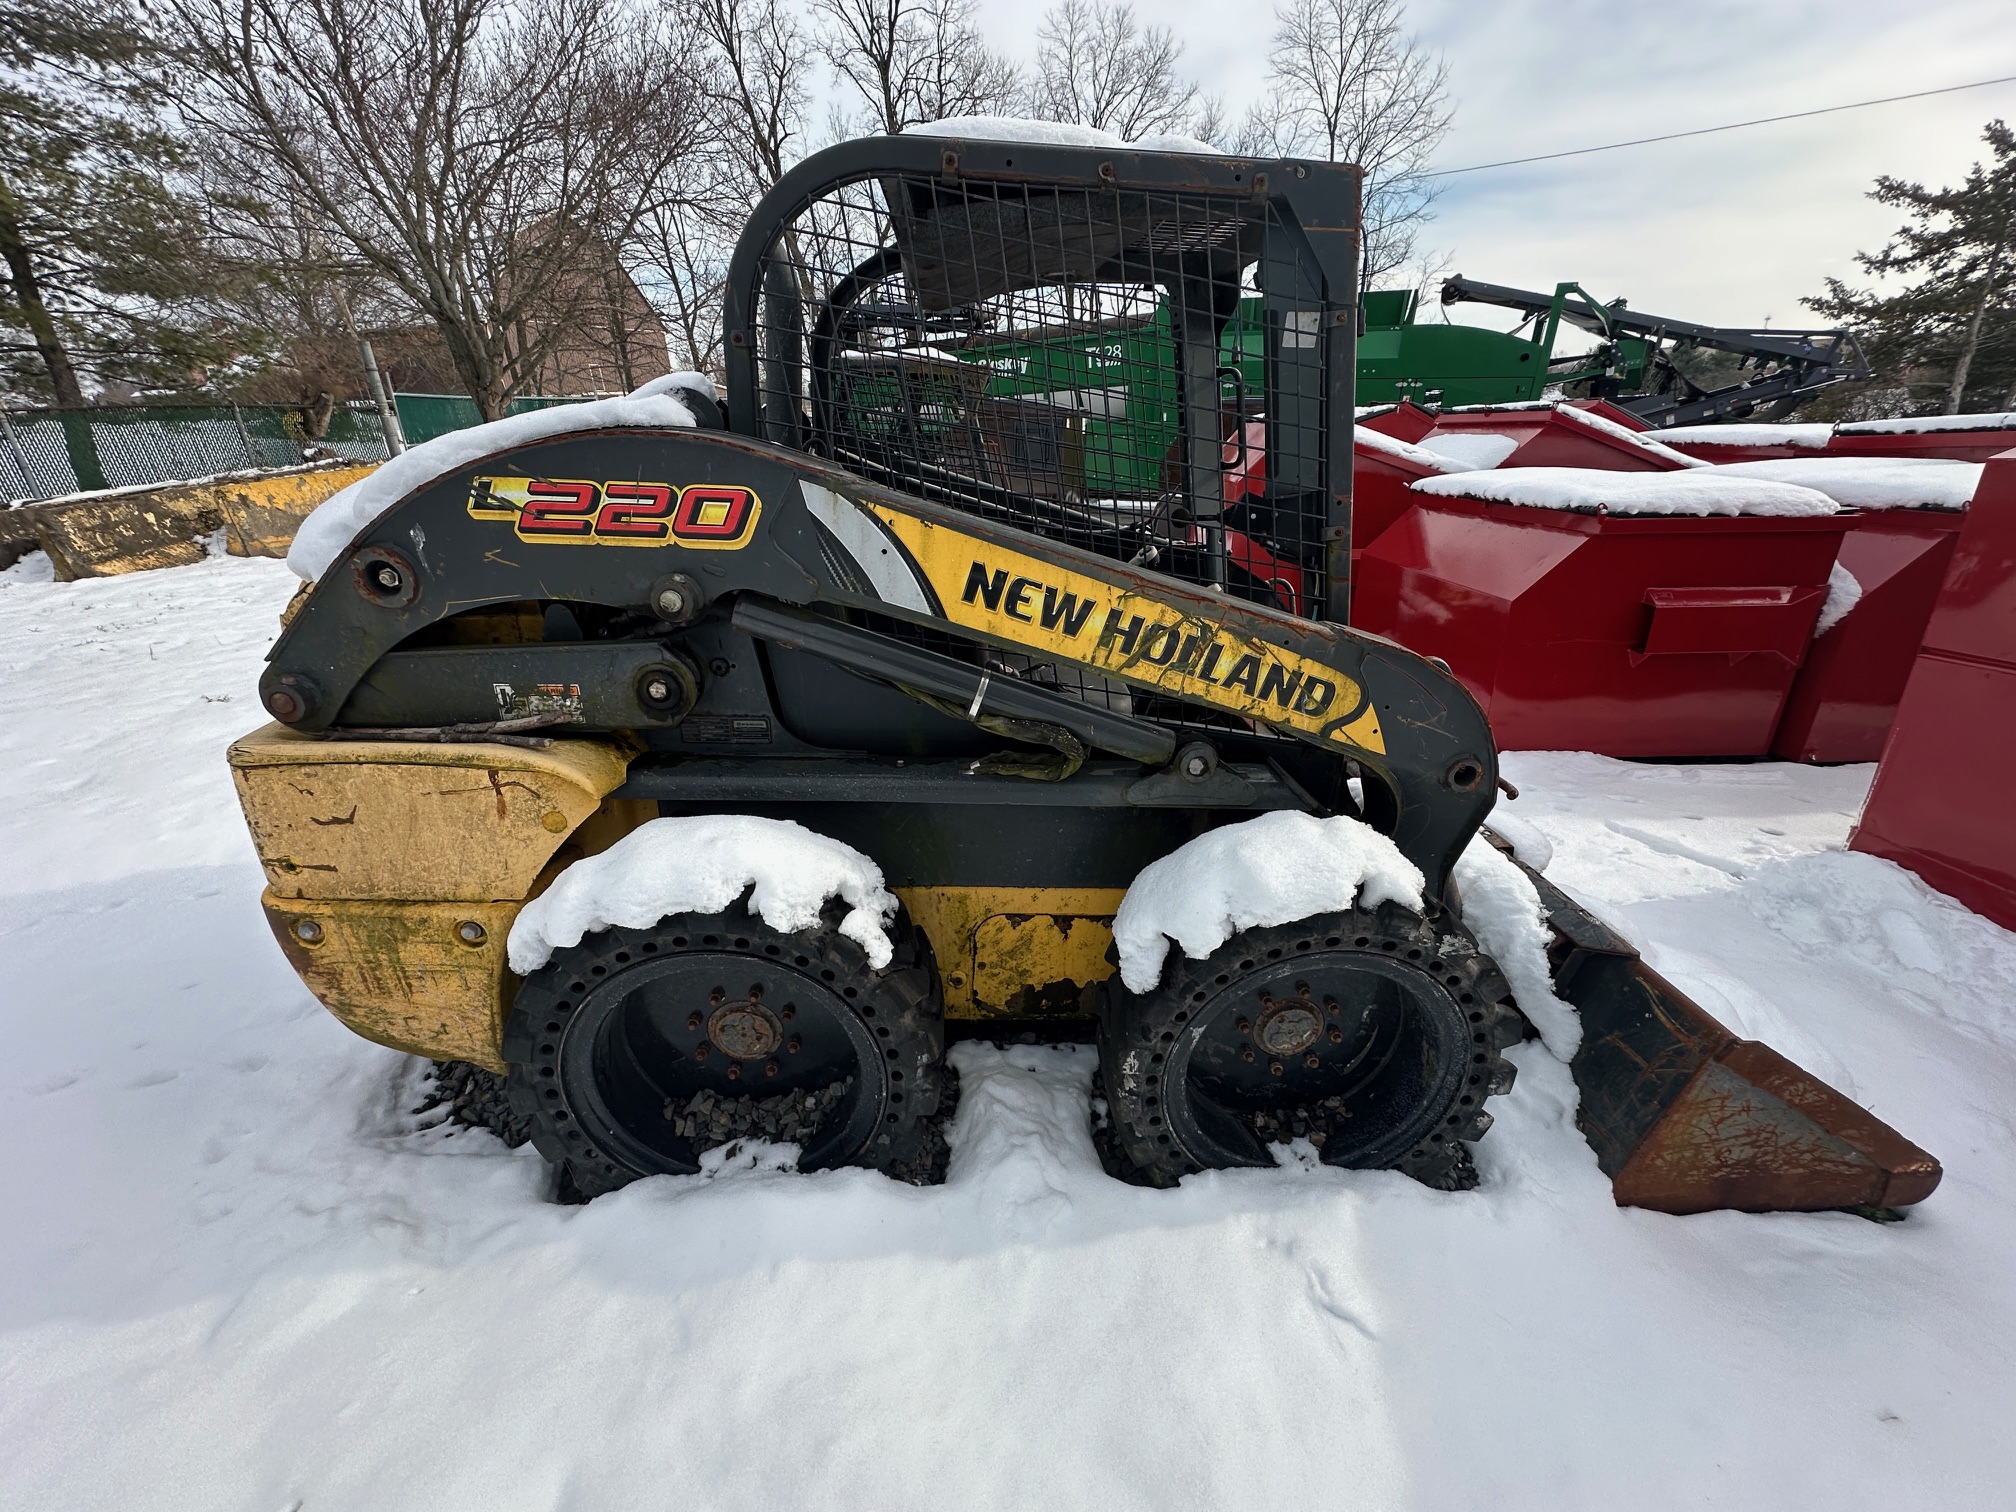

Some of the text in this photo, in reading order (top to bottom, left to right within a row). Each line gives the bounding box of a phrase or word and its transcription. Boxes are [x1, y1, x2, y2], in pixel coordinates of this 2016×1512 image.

[467, 477, 761, 548] L220
[961, 560, 1337, 717] NEW HOLLAND
